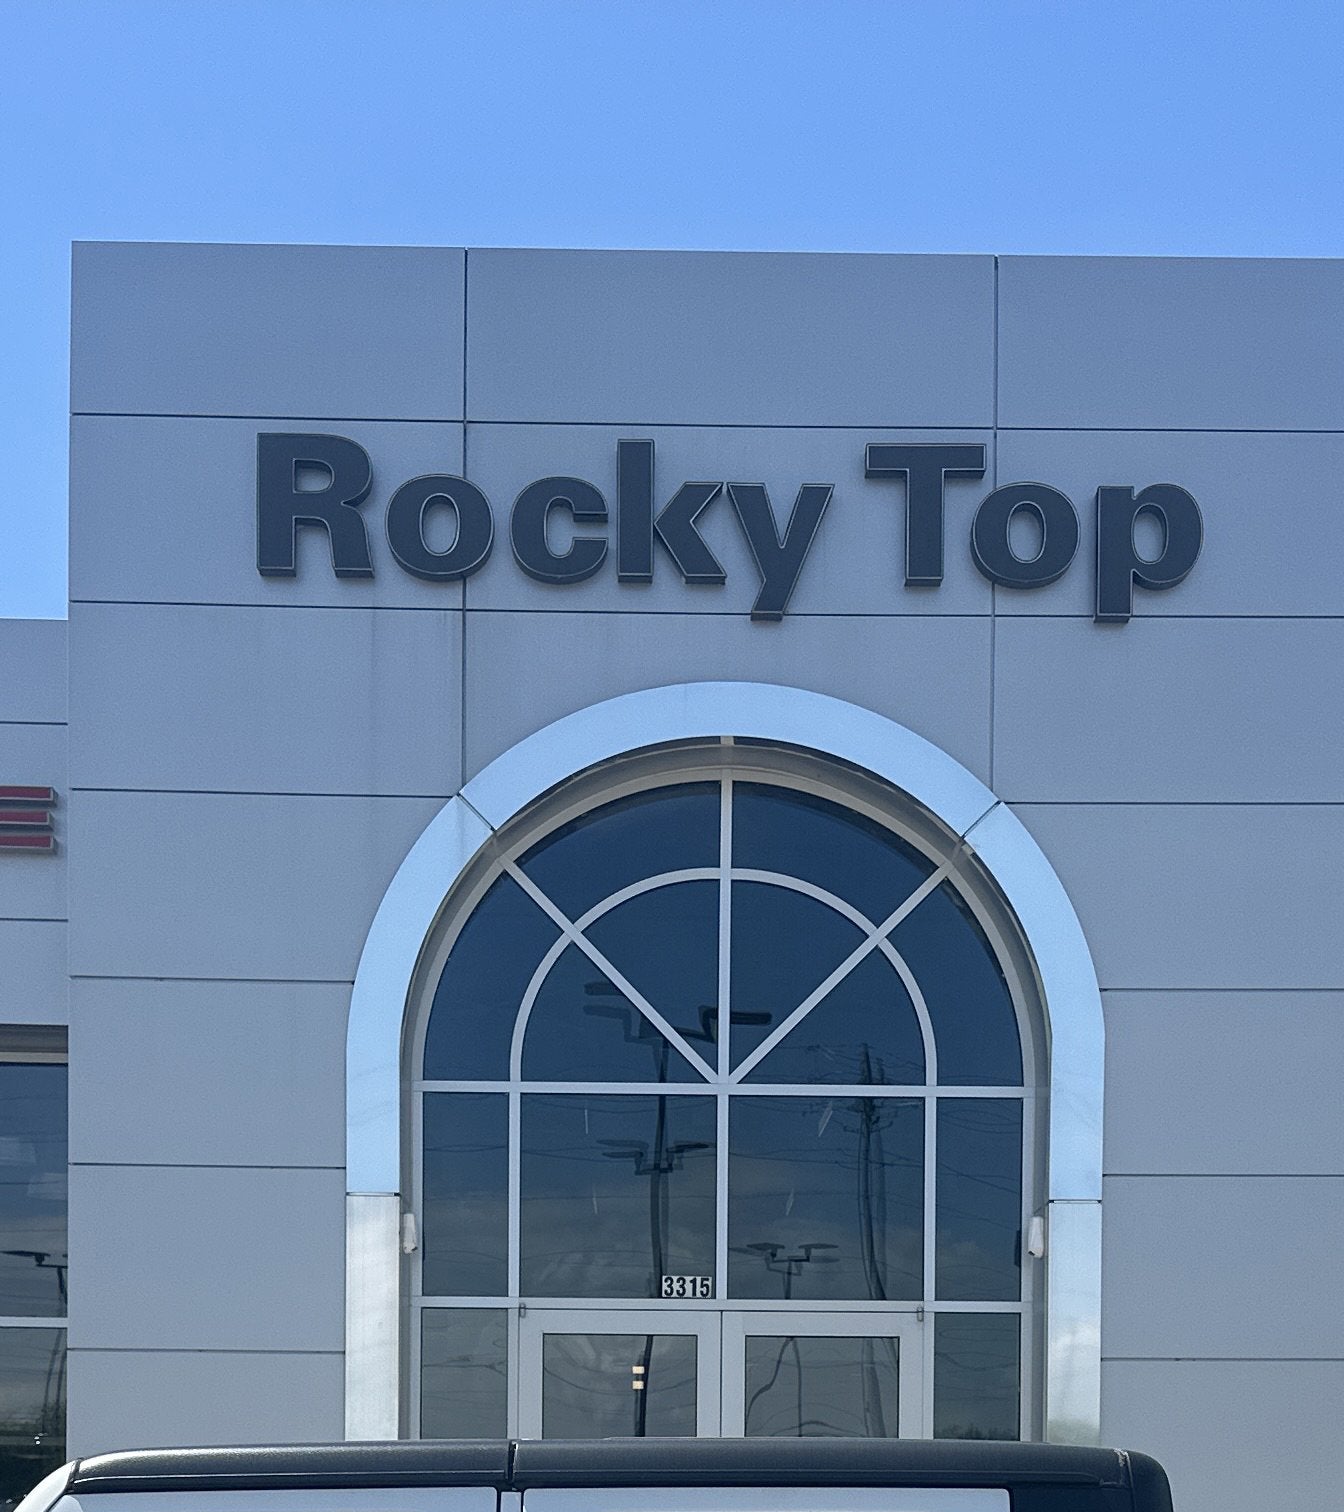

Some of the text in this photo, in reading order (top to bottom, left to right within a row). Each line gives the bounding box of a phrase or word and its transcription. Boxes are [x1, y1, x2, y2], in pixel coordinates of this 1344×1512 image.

[255, 432, 1204, 623] Rocky Top
[663, 1276, 710, 1297] 3315
